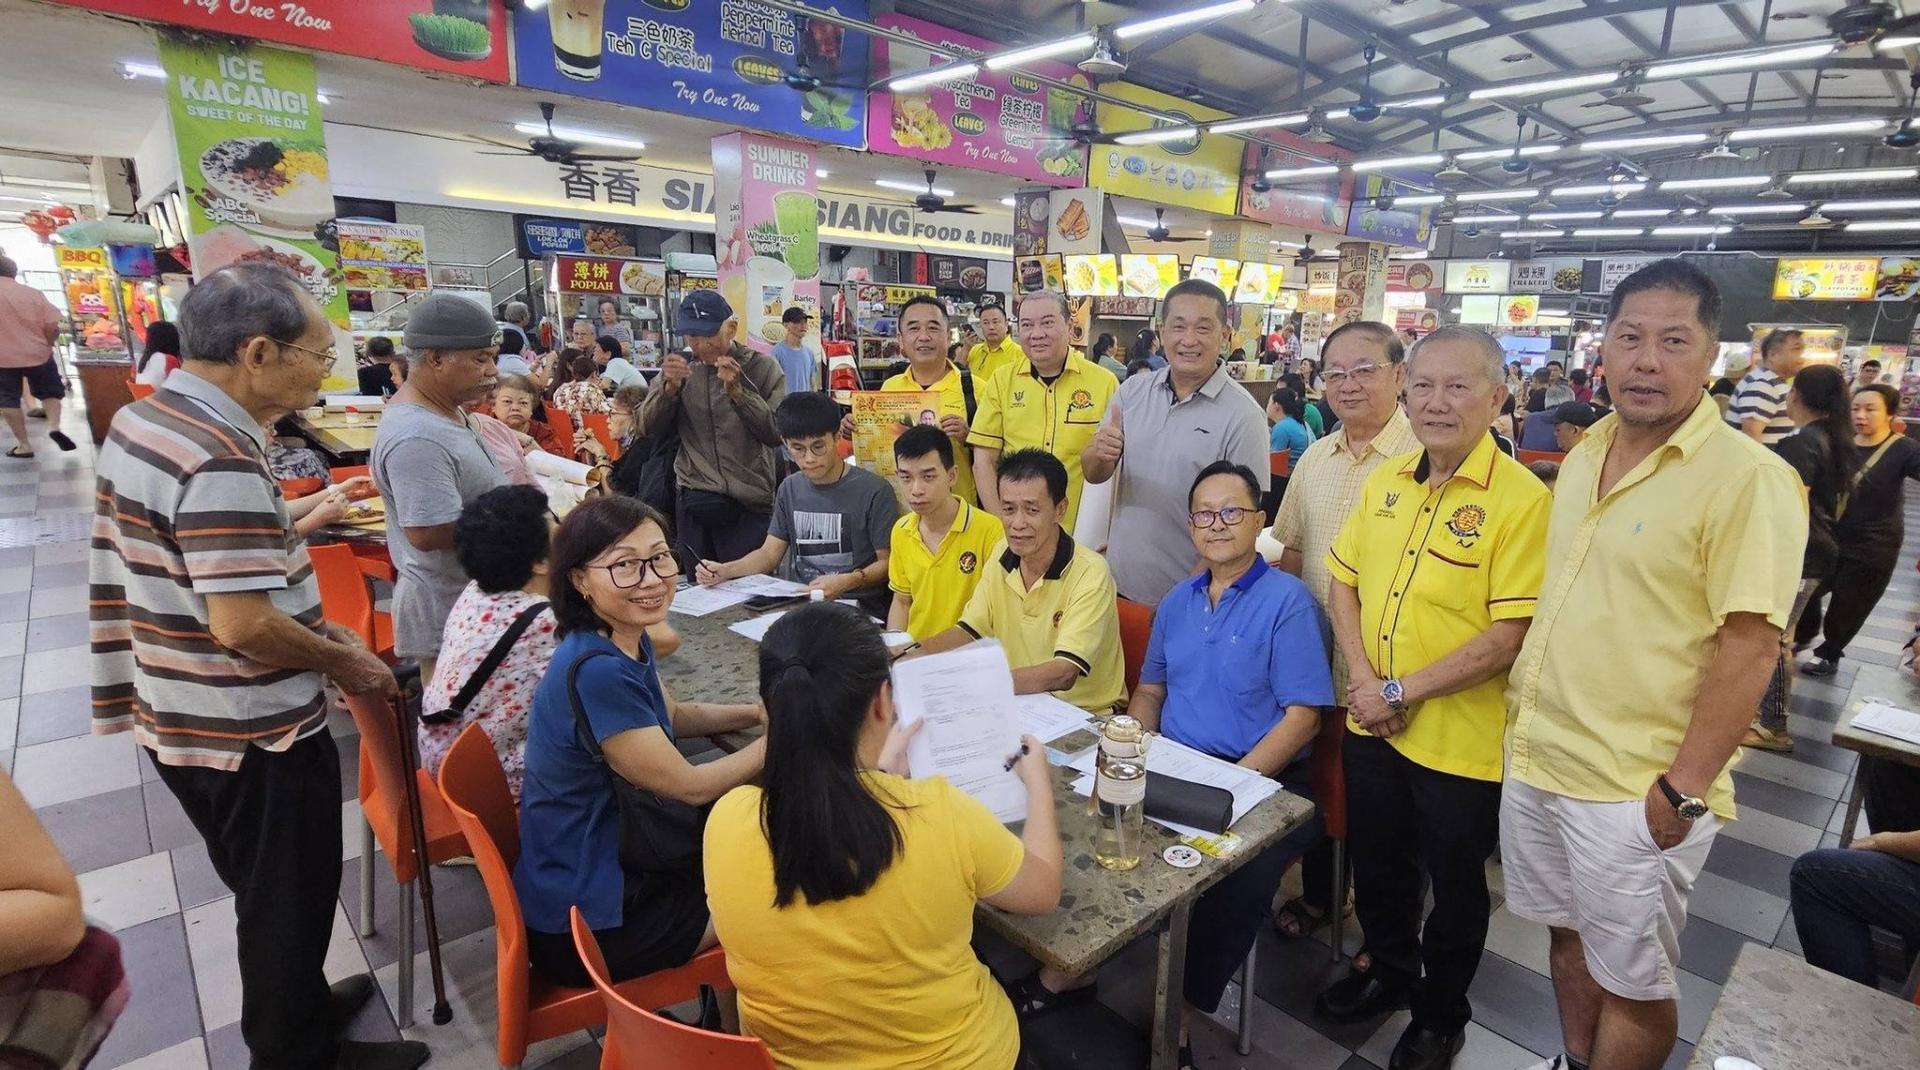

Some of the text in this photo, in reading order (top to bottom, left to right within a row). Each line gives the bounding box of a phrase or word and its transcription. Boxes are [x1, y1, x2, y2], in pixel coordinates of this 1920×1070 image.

[281, 3, 331, 30] Now
[721, 2, 795, 36] Peppermint
[627, 18, 694, 51] 三色奶茶
[721, 21, 795, 55] Herbal Tea
[605, 33, 712, 73] Teh C Special
[218, 54, 266, 84] ICE
[178, 74, 309, 114] KACANG!
[672, 81, 760, 113] Try One Now
[954, 93, 971, 109] Tea
[187, 104, 308, 131] SWEET OF THE DAY
[954, 114, 985, 132] LEAVES
[748, 144, 810, 170] SUMMER
[963, 141, 1019, 164] Try One Now
[559, 161, 641, 206] 香香
[752, 164, 806, 187] DRINKS
[212, 198, 249, 211] ABC
[204, 209, 262, 224] Special
[746, 230, 799, 243] Wheatgrass C
[914, 222, 962, 243] FOOD
[965, 229, 977, 245] &
[62, 250, 101, 264] BBQ
[574, 261, 609, 280] 薄饼
[570, 279, 613, 291] POPIAH
[794, 293, 817, 304] Barley
